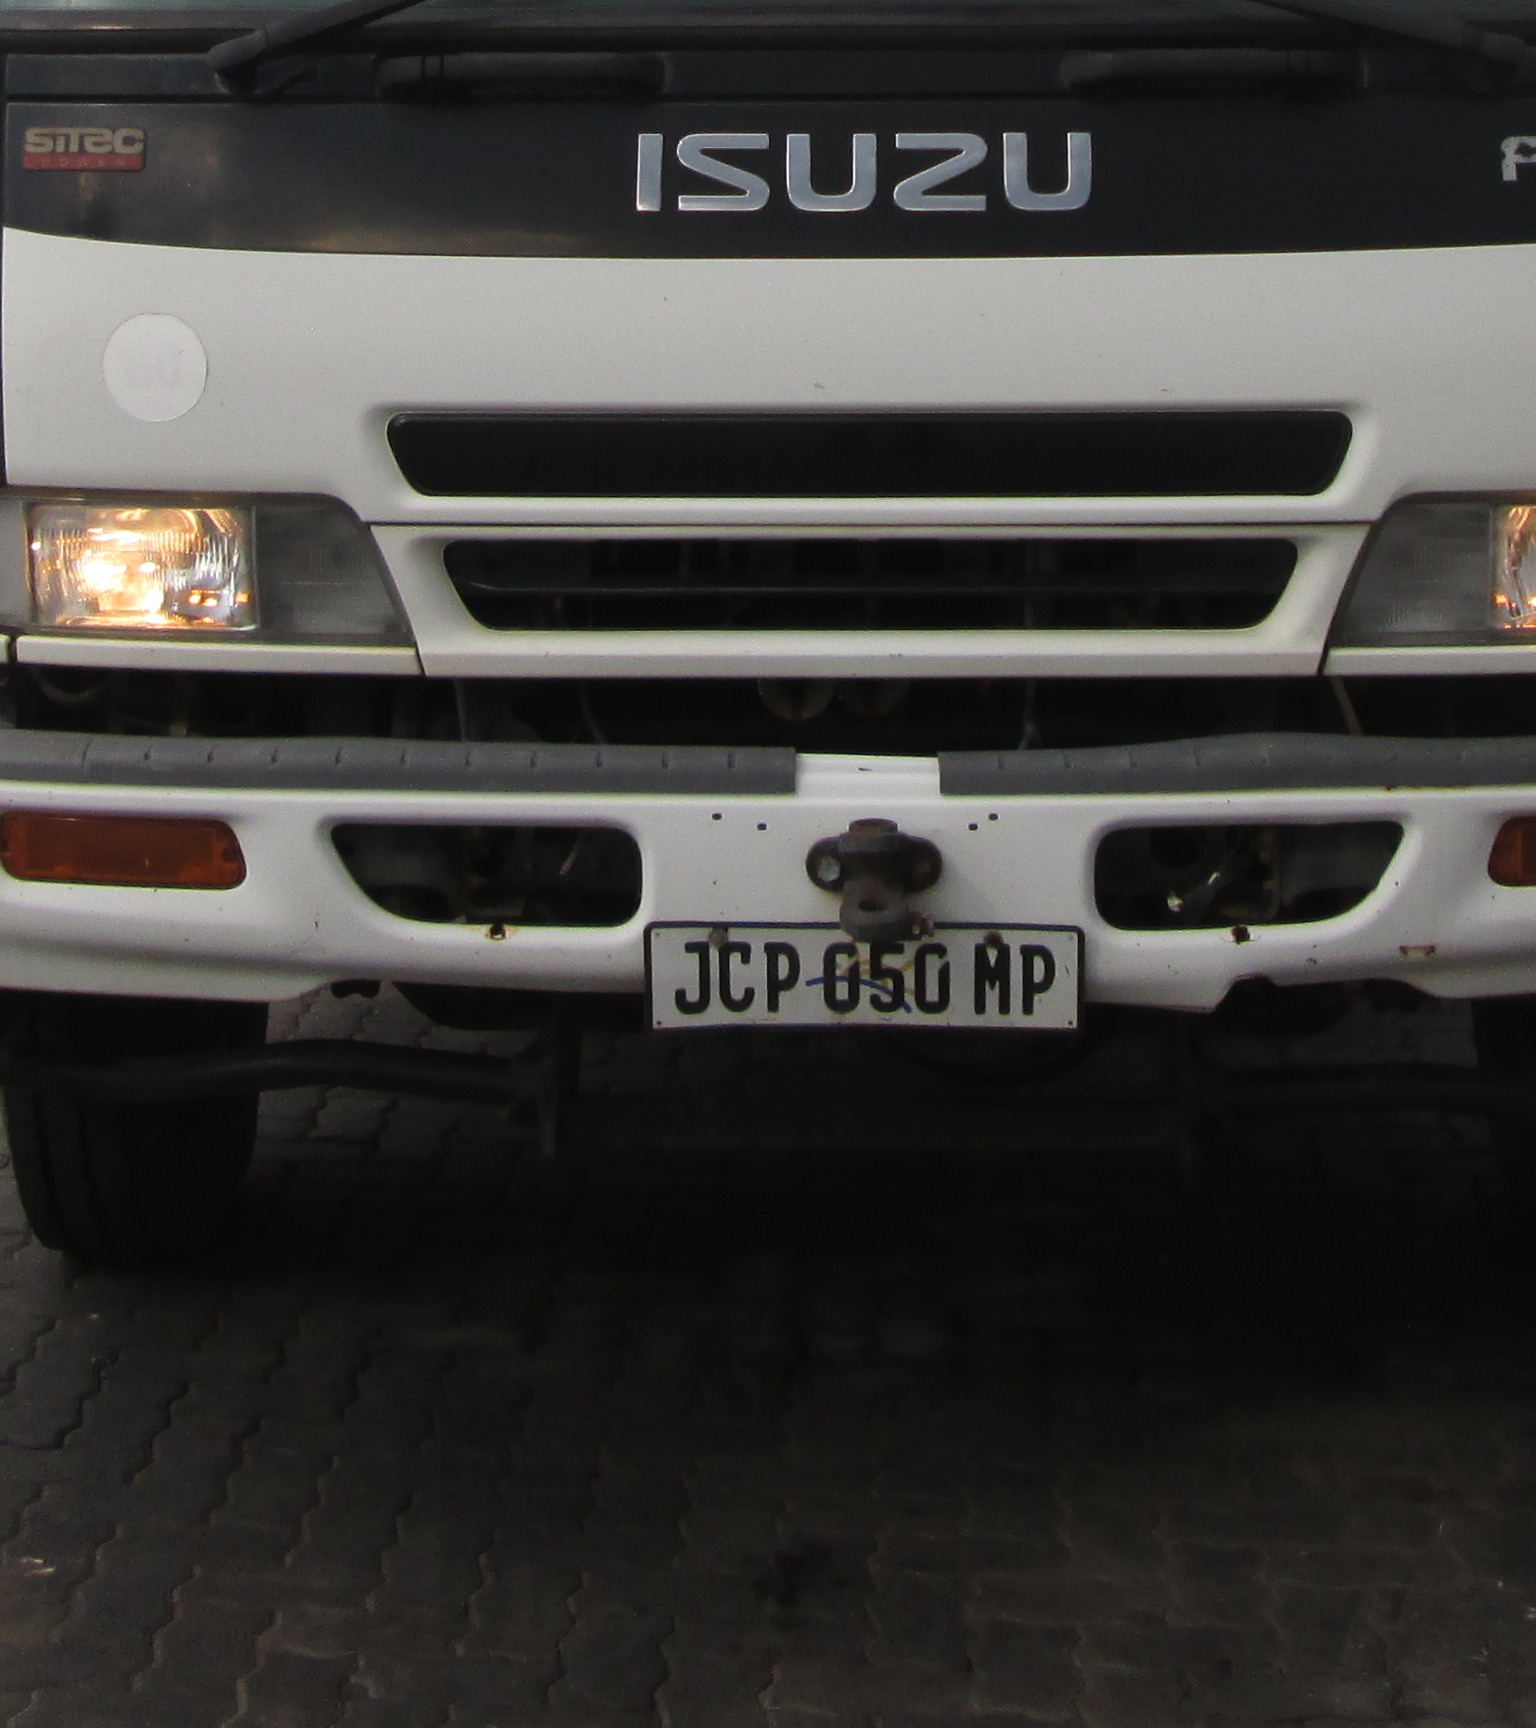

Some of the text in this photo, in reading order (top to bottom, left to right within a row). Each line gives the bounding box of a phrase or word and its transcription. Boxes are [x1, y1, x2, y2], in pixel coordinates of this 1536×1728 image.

[636, 132, 1092, 212] ISUZU
[674, 941, 1056, 1015] JCP 050 MP
